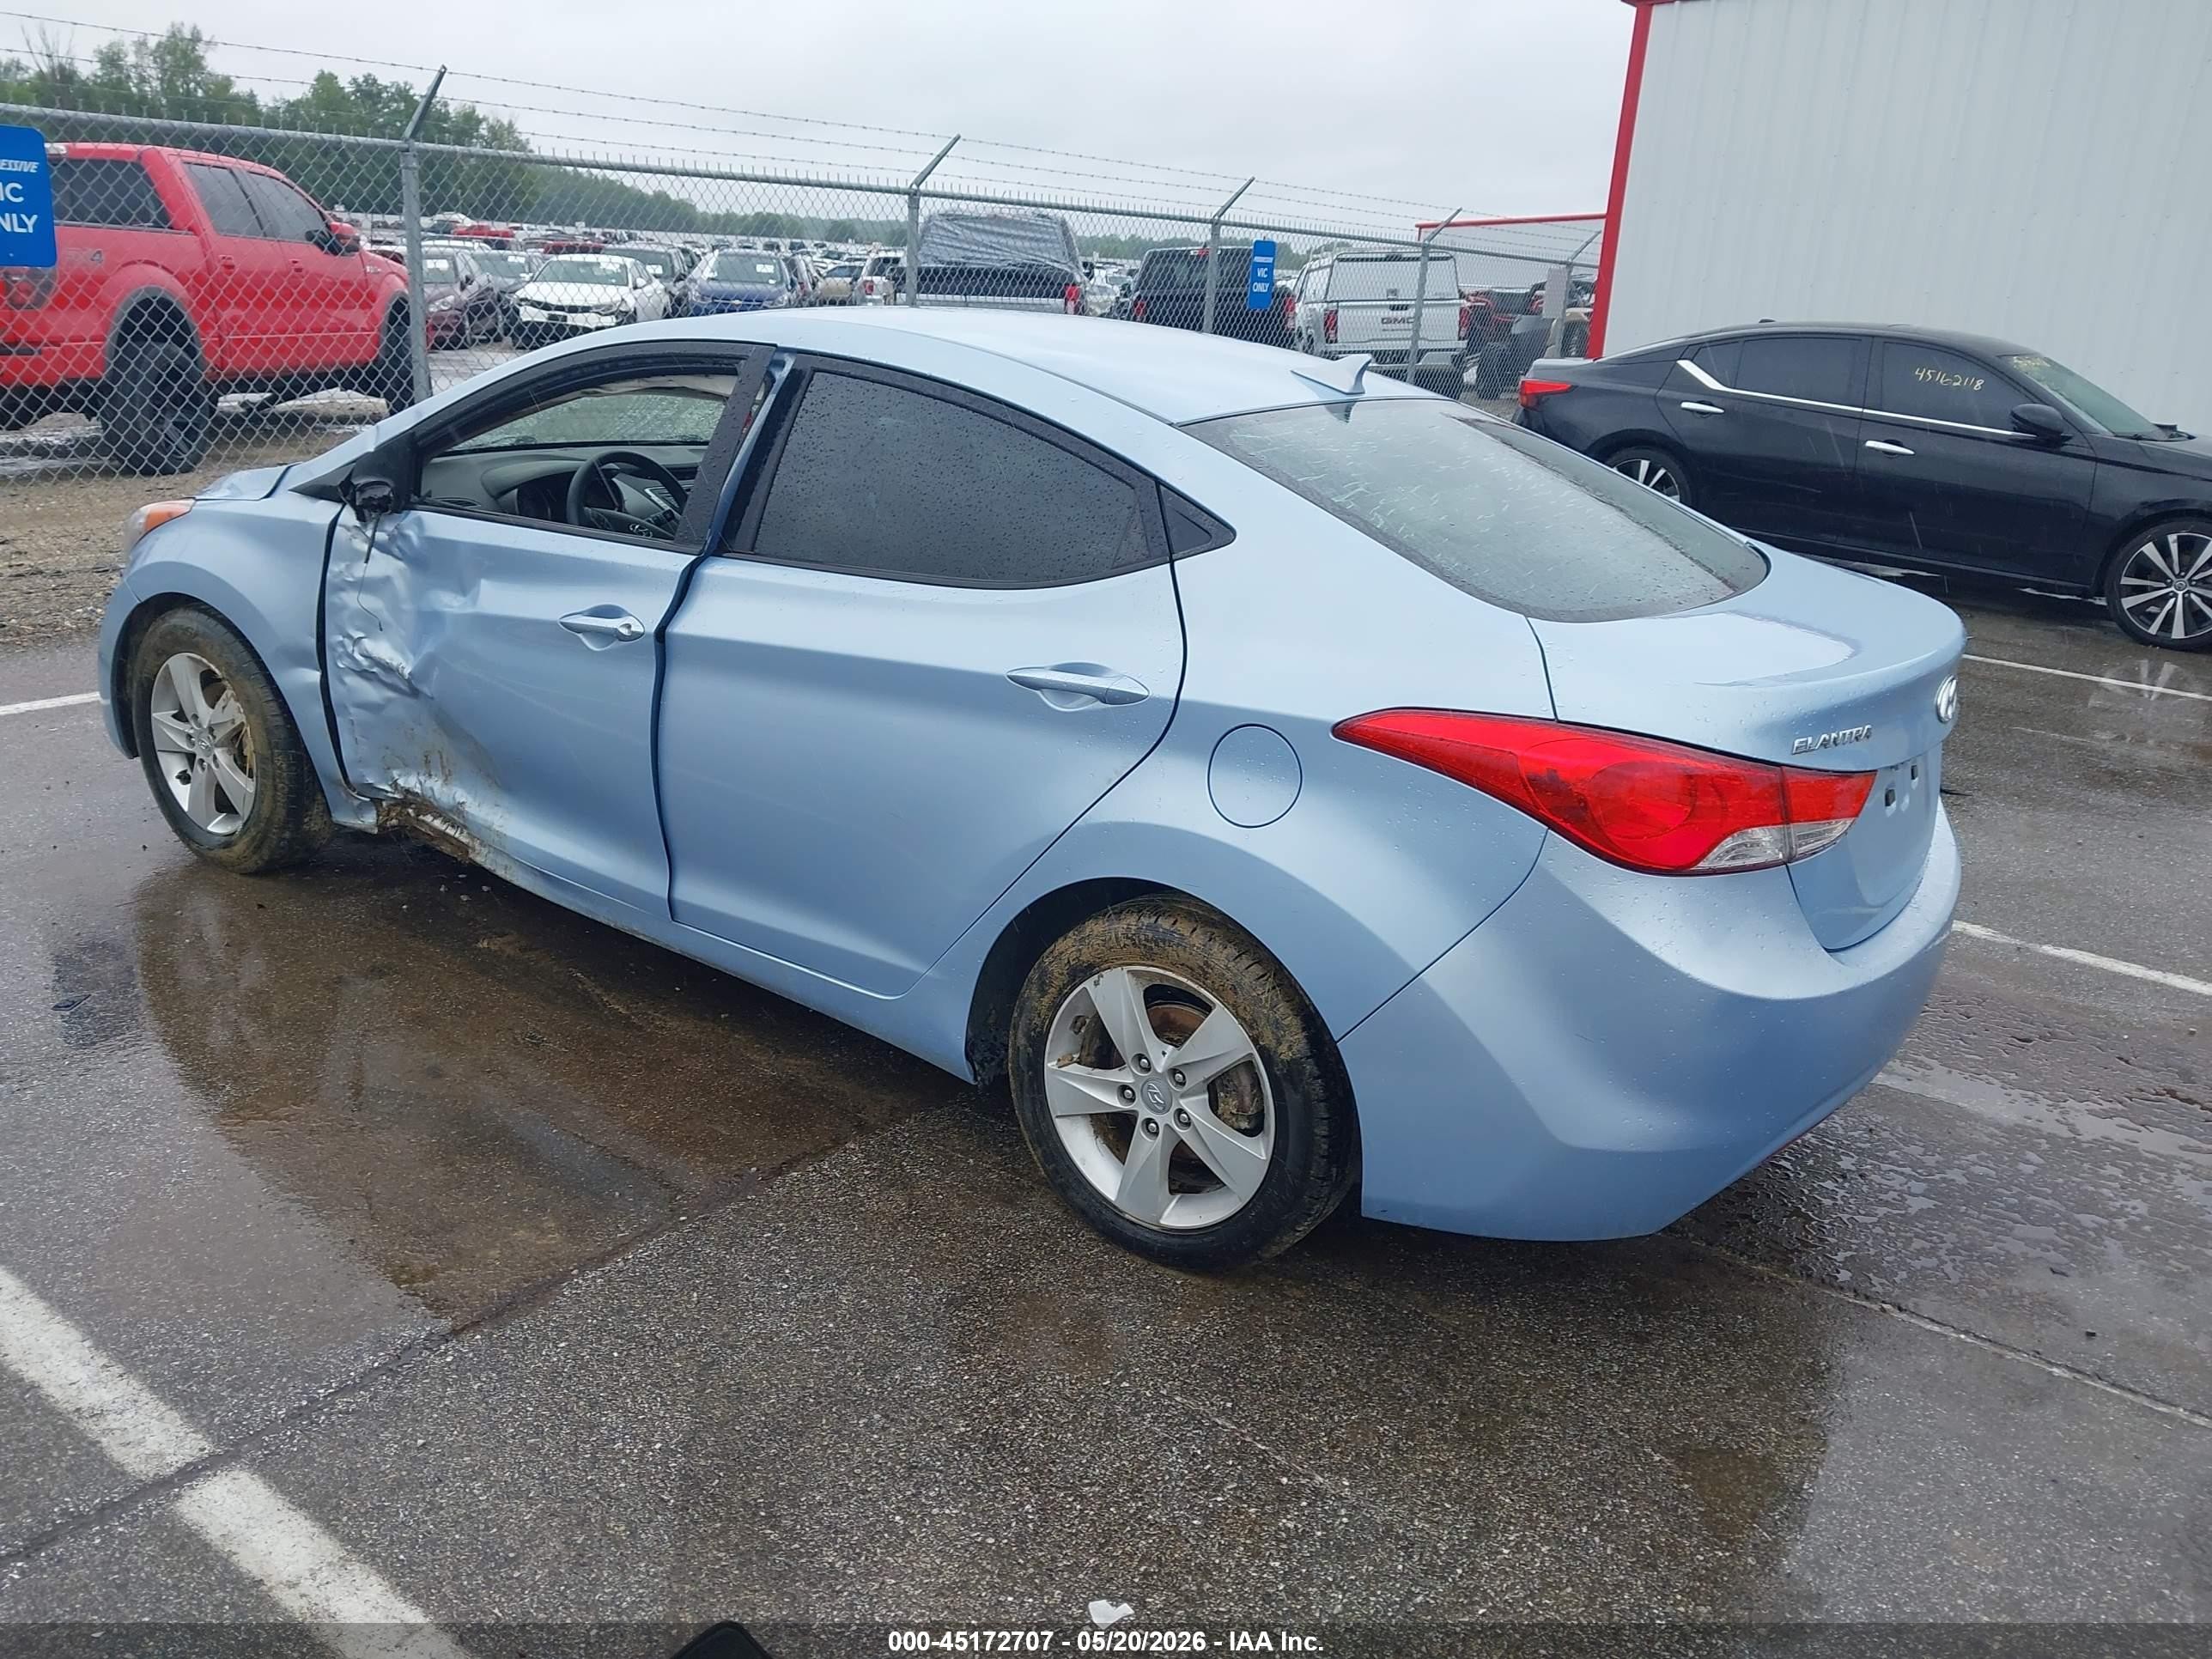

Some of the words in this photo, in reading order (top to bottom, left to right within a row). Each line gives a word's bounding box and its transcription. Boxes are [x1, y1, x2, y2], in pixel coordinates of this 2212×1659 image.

[1257, 267, 1268, 278] VIC
[1252, 282, 1270, 293] ONLY
[1915, 368, 1984, 391] 45162118
[1792, 725, 1873, 756] ELANTRA
